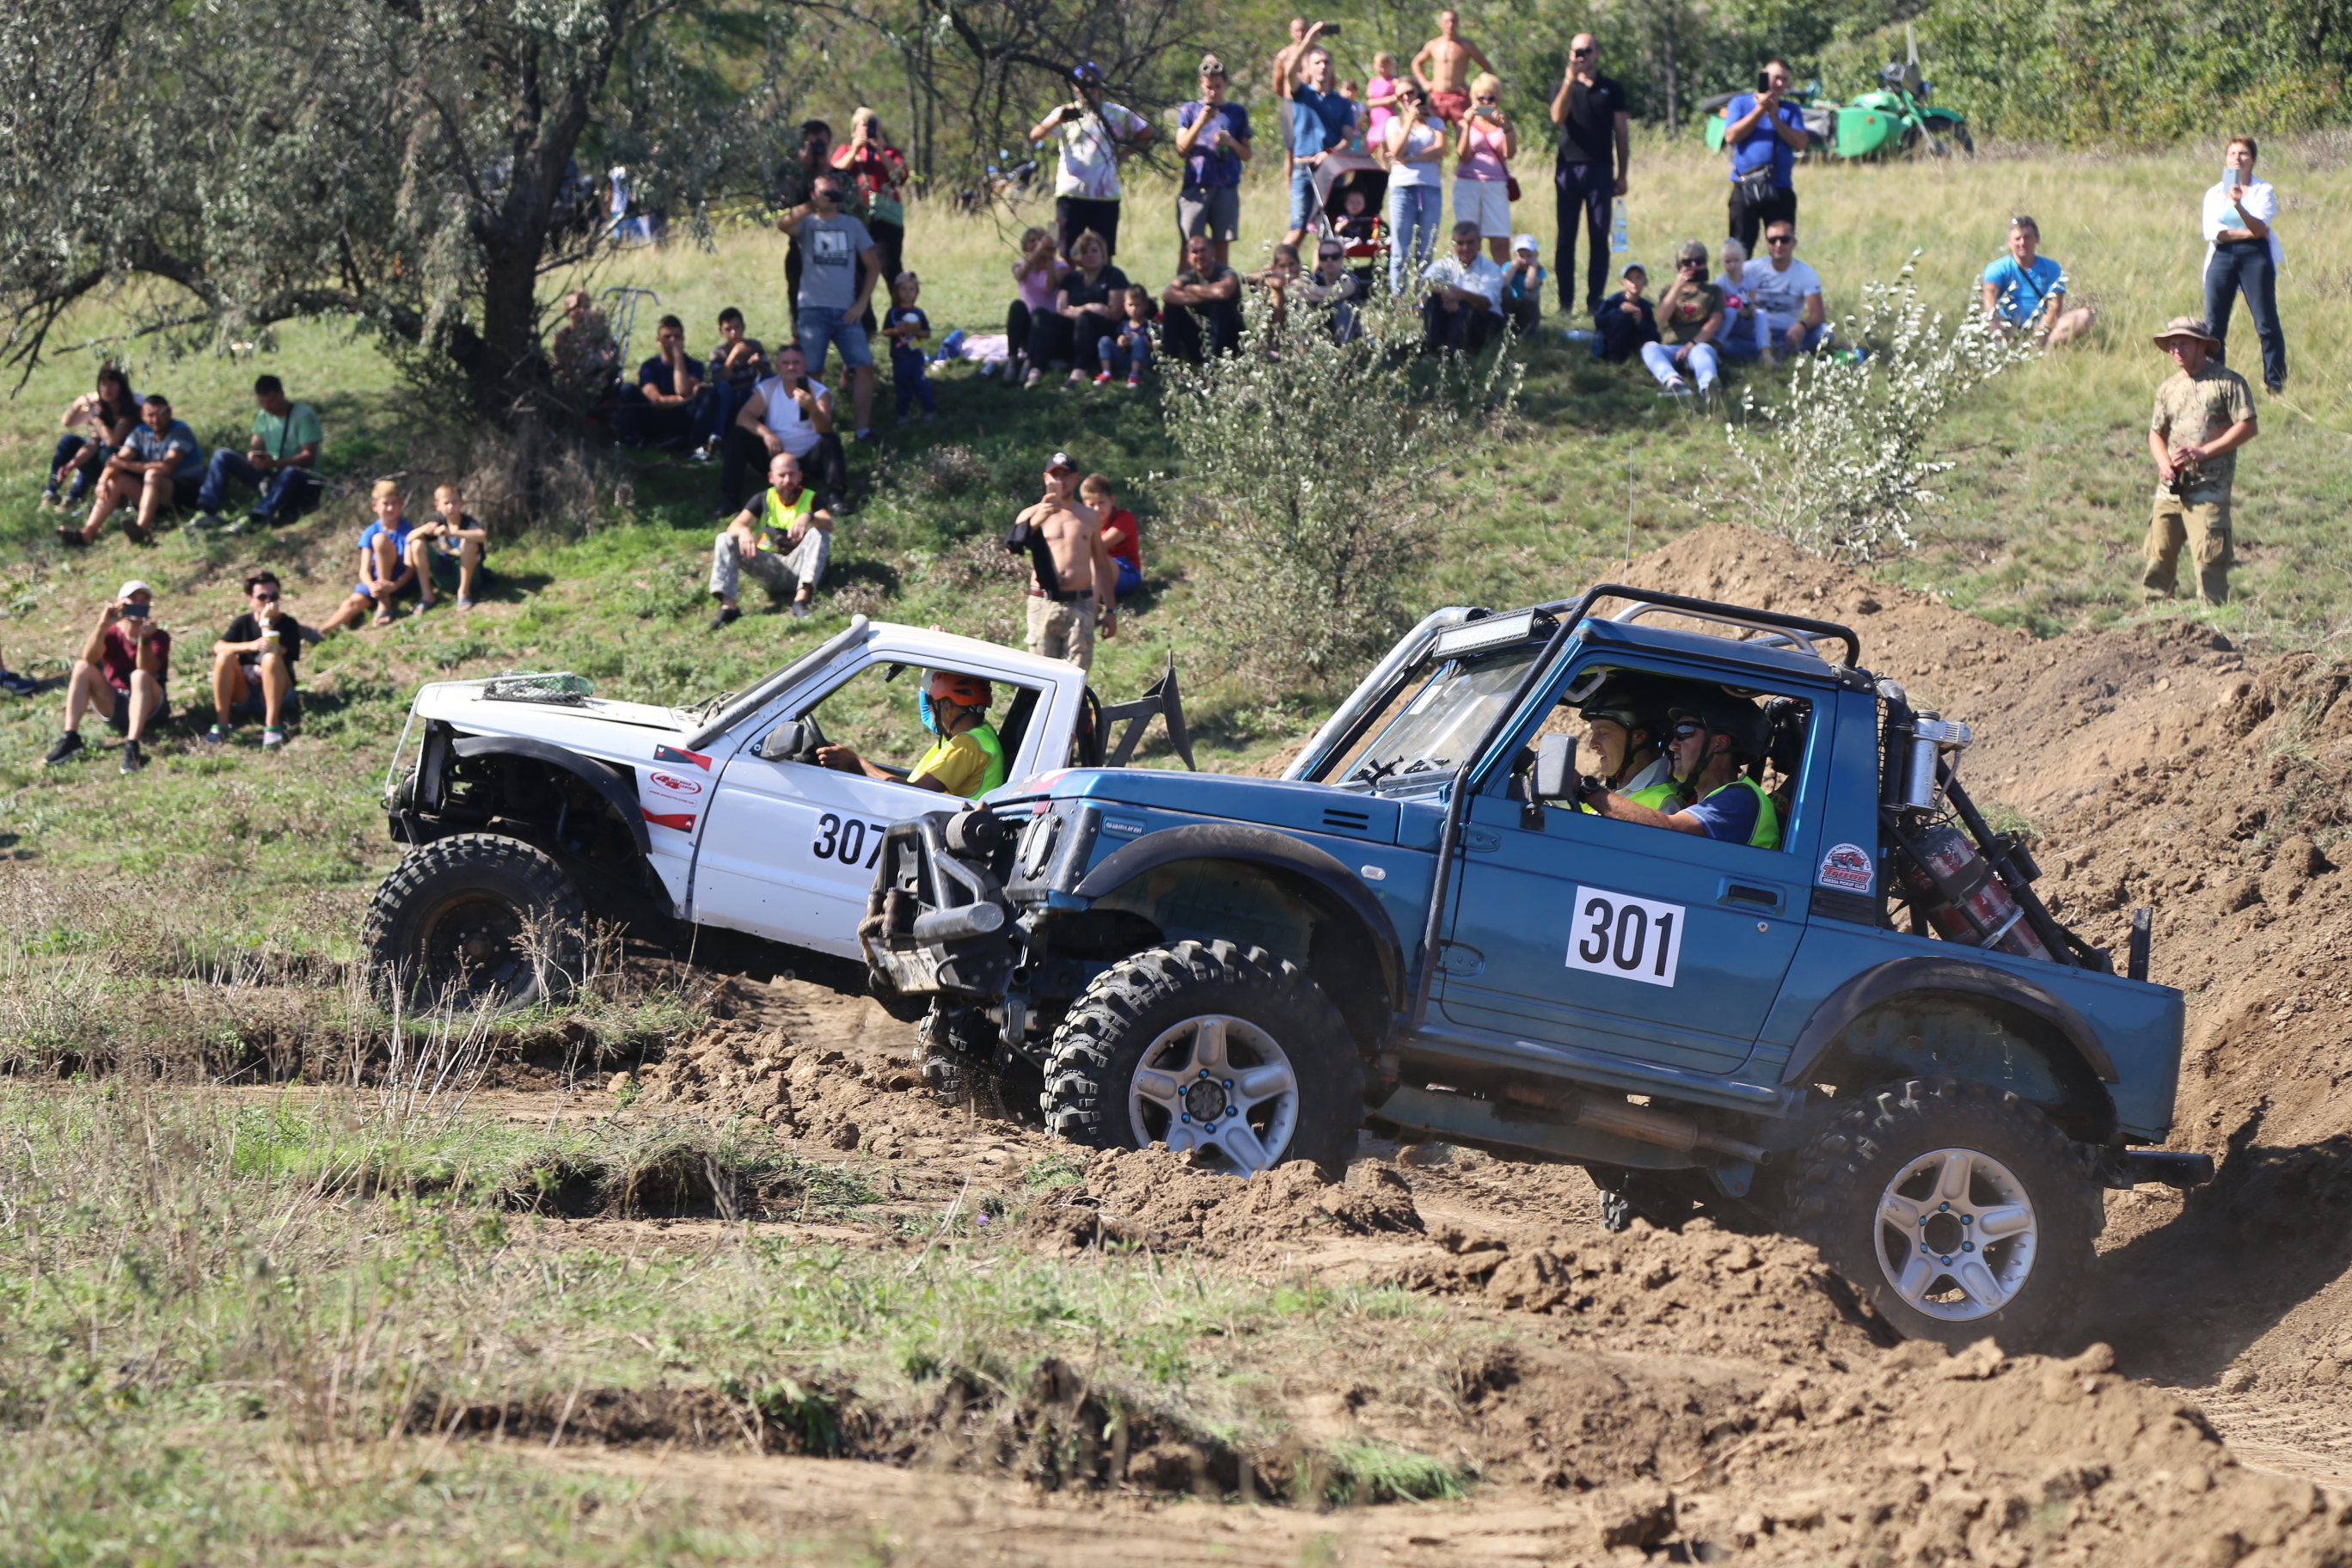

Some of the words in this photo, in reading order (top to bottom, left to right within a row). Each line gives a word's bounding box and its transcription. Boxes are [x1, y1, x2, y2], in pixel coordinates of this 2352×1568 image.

[813, 813, 887, 870] 307
[1824, 866, 1870, 883] Triton
[1579, 897, 1674, 977] 301
